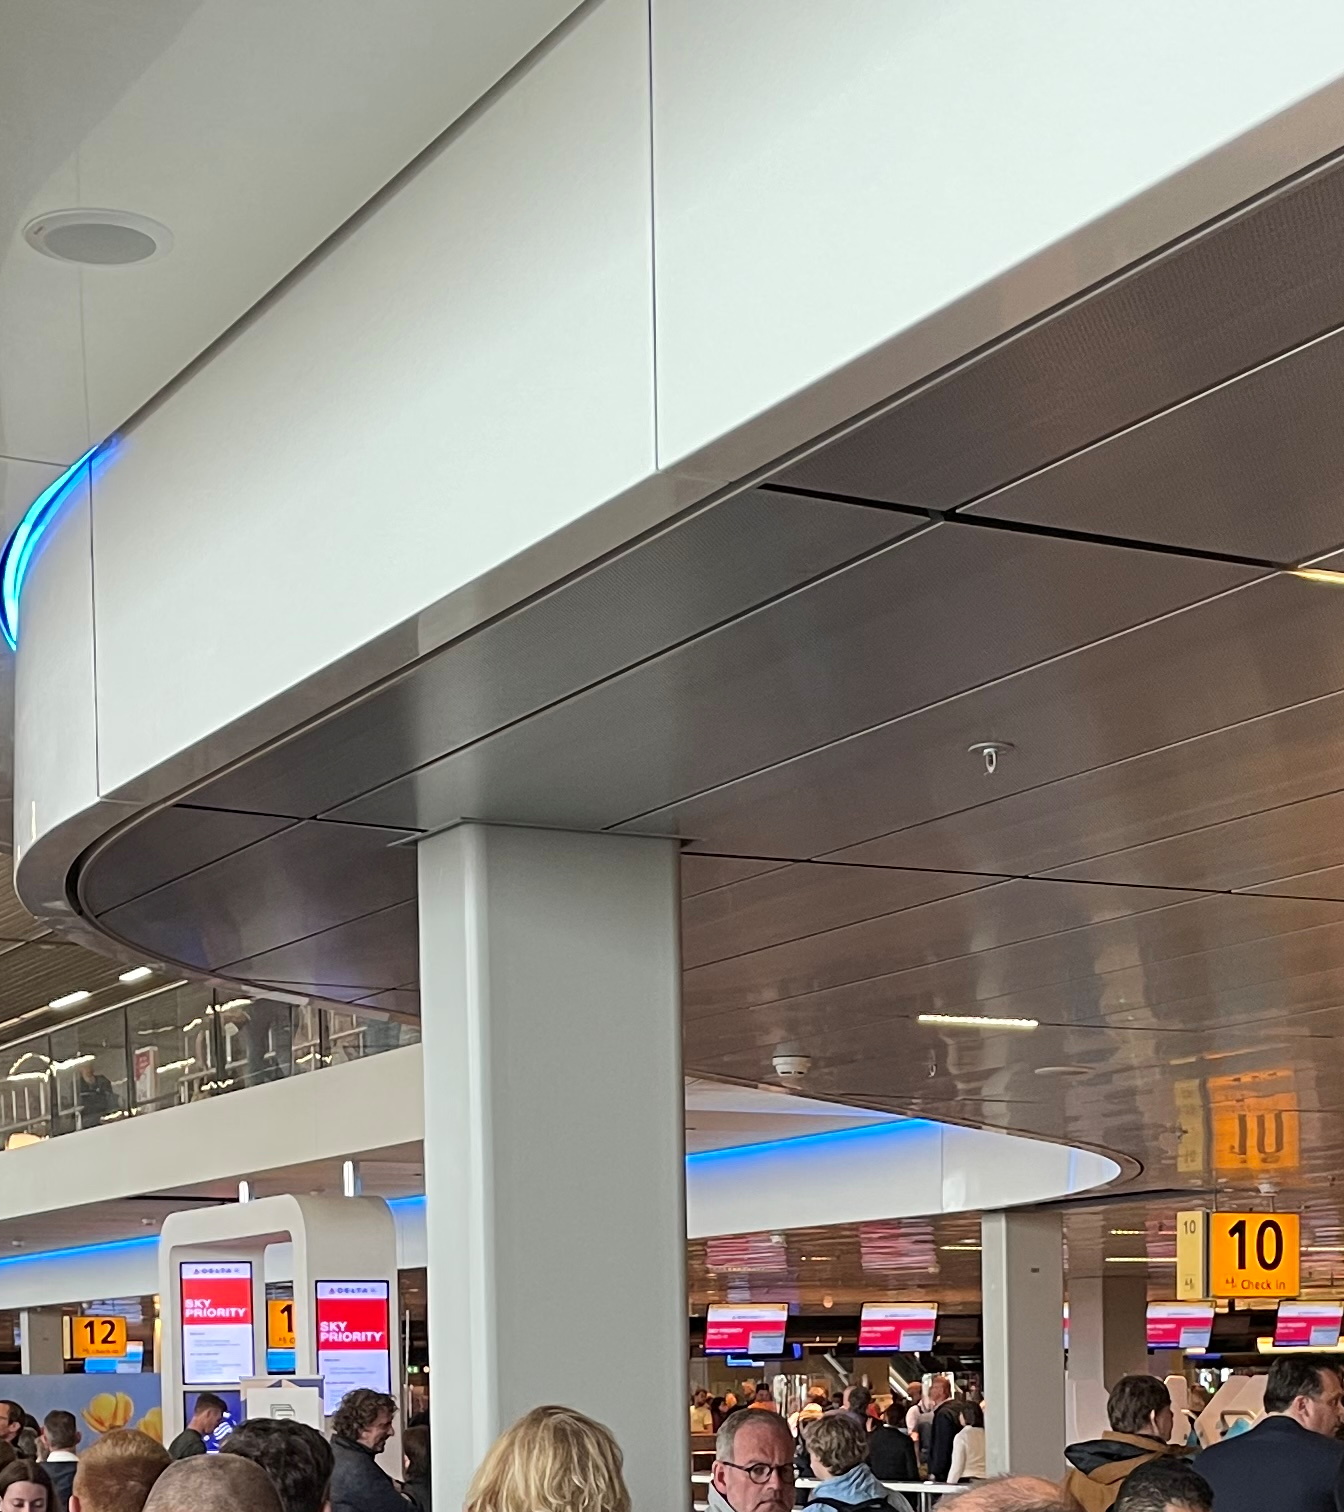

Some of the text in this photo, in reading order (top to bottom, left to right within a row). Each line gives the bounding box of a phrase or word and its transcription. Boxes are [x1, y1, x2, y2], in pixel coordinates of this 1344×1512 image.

[1183, 1220, 1196, 1234] 10
[1228, 1219, 1284, 1271] 10
[185, 1299, 211, 1308] SKY
[185, 1308, 246, 1318] PRIORITY
[84, 1320, 116, 1344] 12
[320, 1321, 347, 1332] SKY
[320, 1331, 384, 1342] PRIORITY
